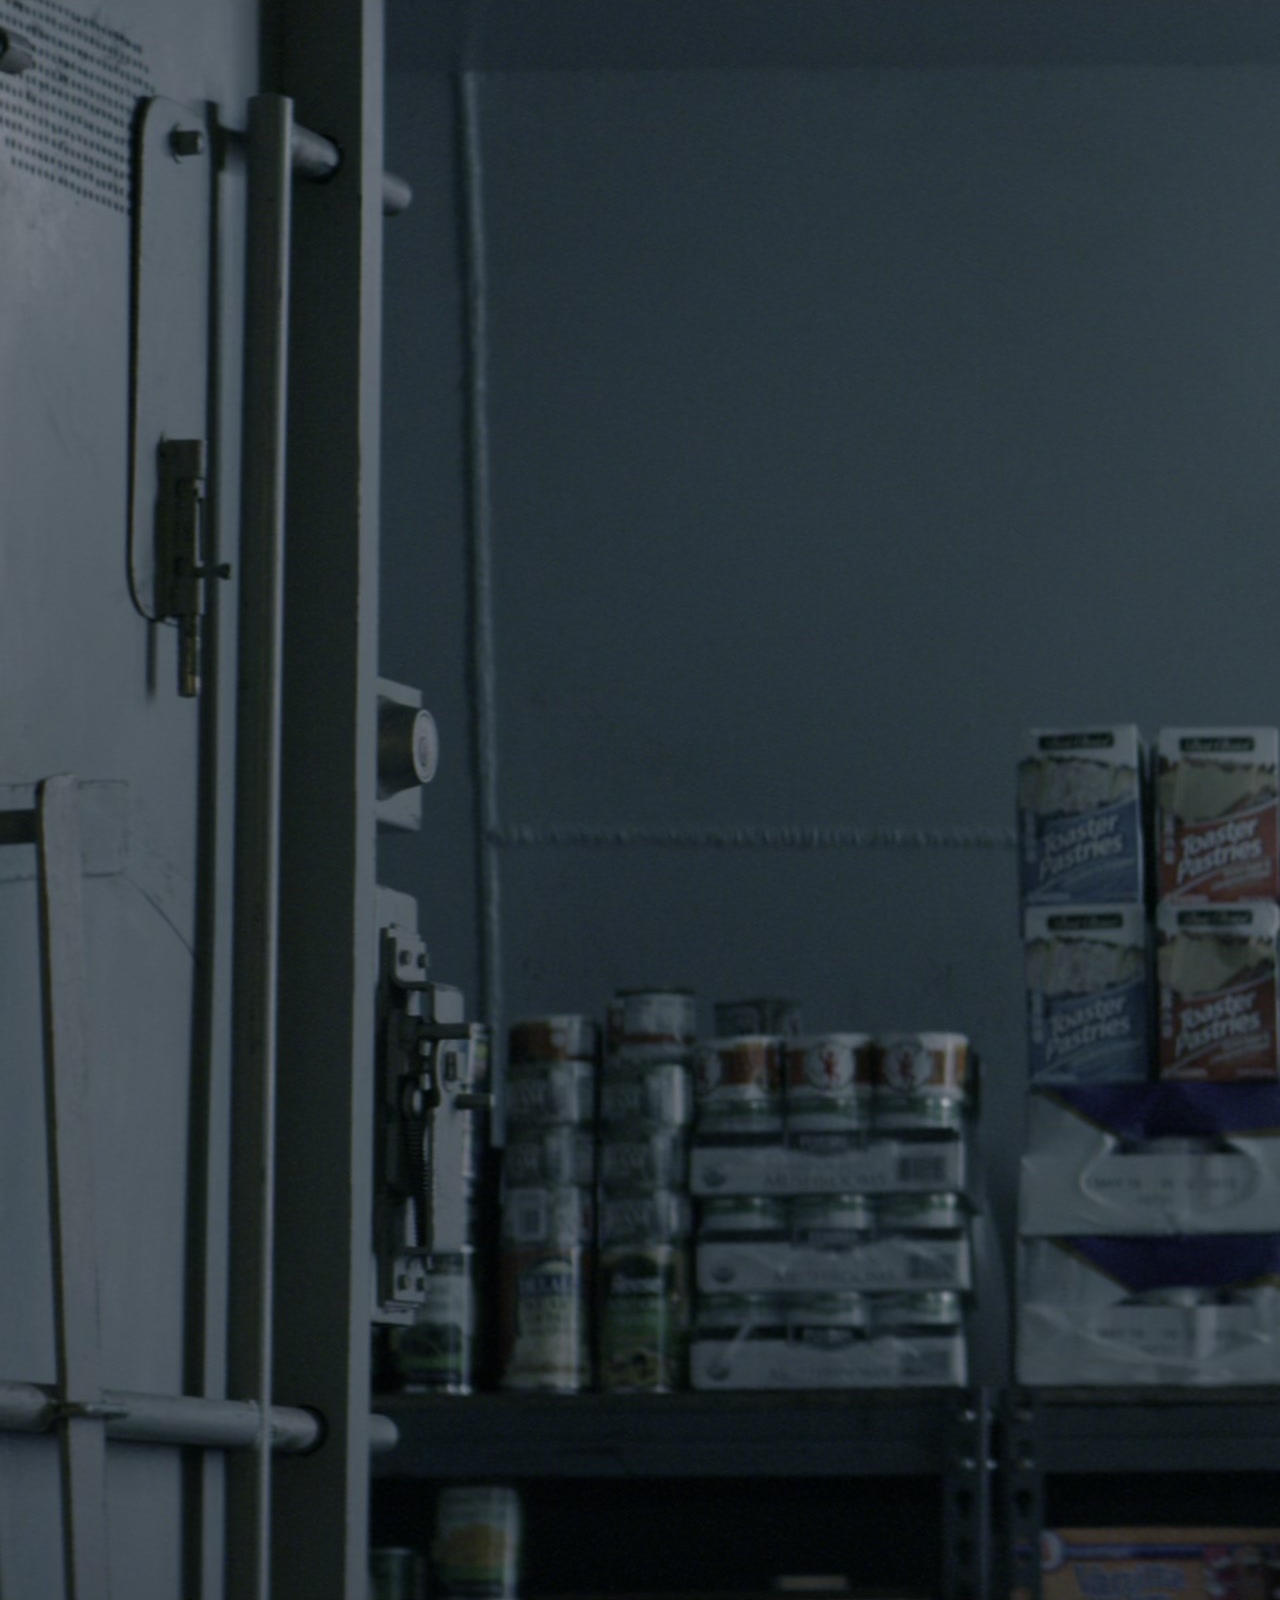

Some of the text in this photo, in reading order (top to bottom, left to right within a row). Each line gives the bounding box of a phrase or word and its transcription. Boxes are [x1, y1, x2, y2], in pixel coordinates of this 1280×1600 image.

[1043, 813, 1119, 856] Toaster
[1181, 817, 1259, 857] Toaster
[1038, 834, 1123, 882] Pastries
[1177, 837, 1262, 884] Pastries
[1050, 995, 1126, 1037] Toaster
[1179, 992, 1257, 1031] Toaster
[1045, 1014, 1130, 1061] Pastries
[1175, 1011, 1261, 1058] Pastries
